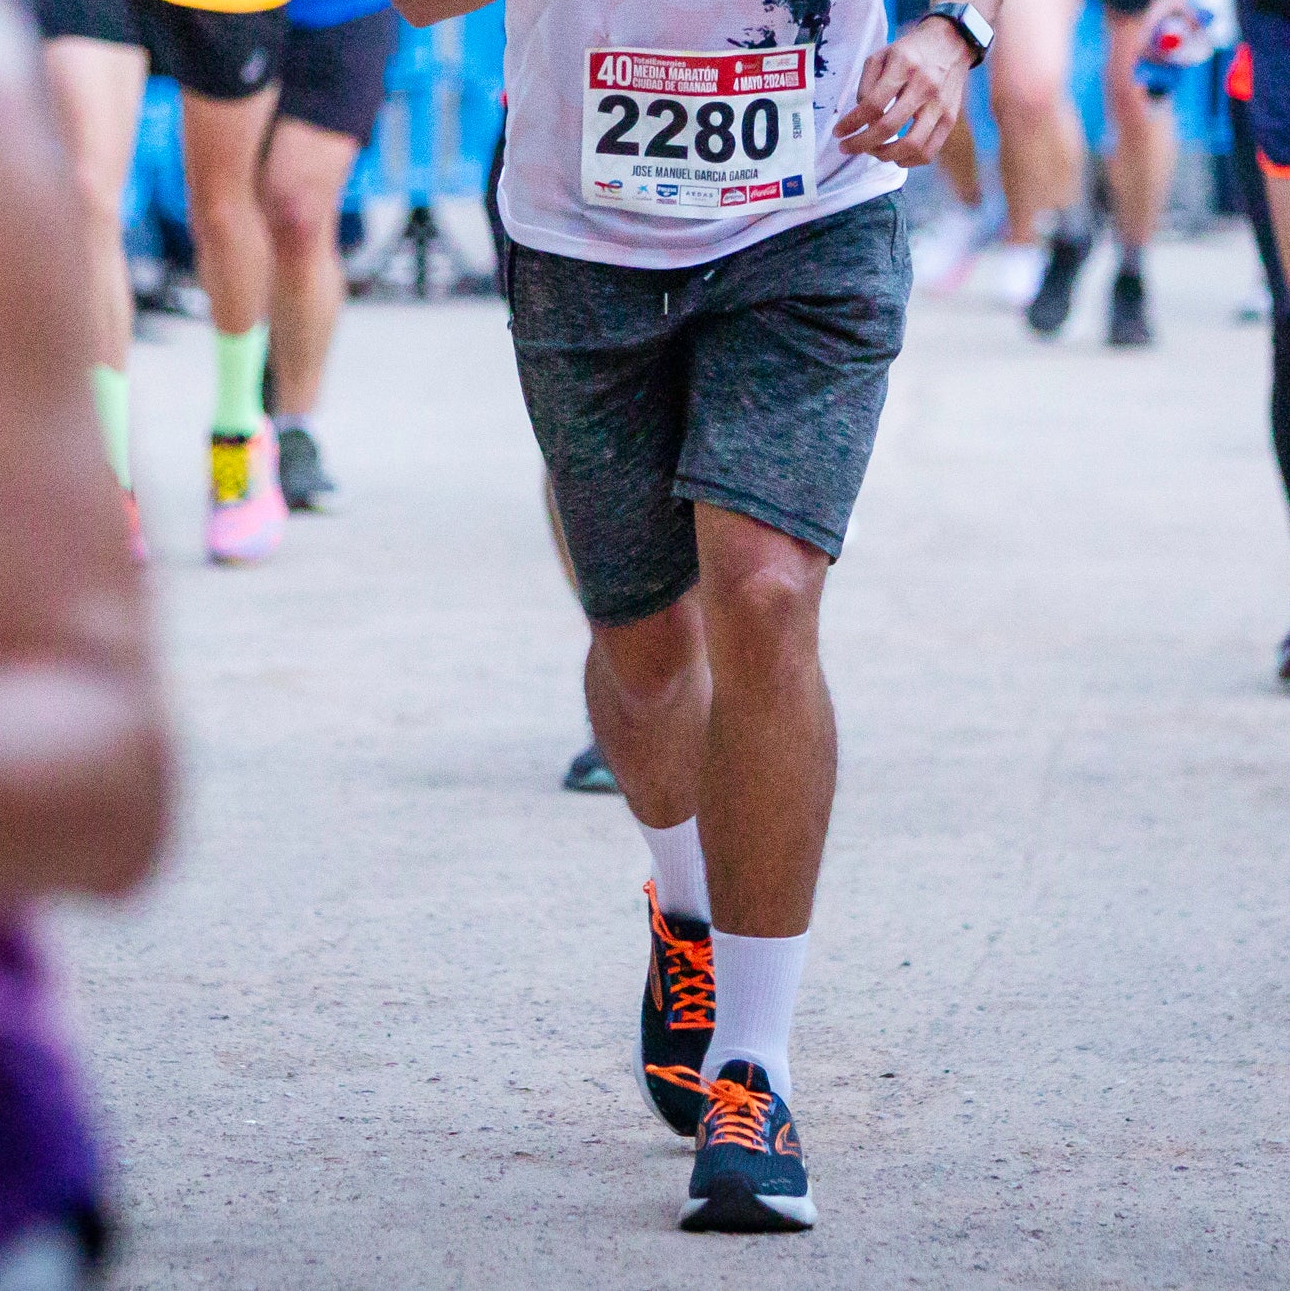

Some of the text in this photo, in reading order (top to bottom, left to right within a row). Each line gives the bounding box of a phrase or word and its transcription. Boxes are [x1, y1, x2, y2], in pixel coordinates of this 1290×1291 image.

[597, 55, 632, 87] 40
[633, 64, 719, 82] MEDIA MARATÓN
[632, 77, 718, 93] CIUDAD DE GRANADA
[733, 77, 739, 92] 4
[740, 75, 763, 92] MAYO
[763, 72, 786, 89] 2024
[595, 94, 780, 164] 2280
[792, 112, 802, 140] SENIOR
[631, 165, 759, 182] JOSE MANUEL GARCIA GARCIA
